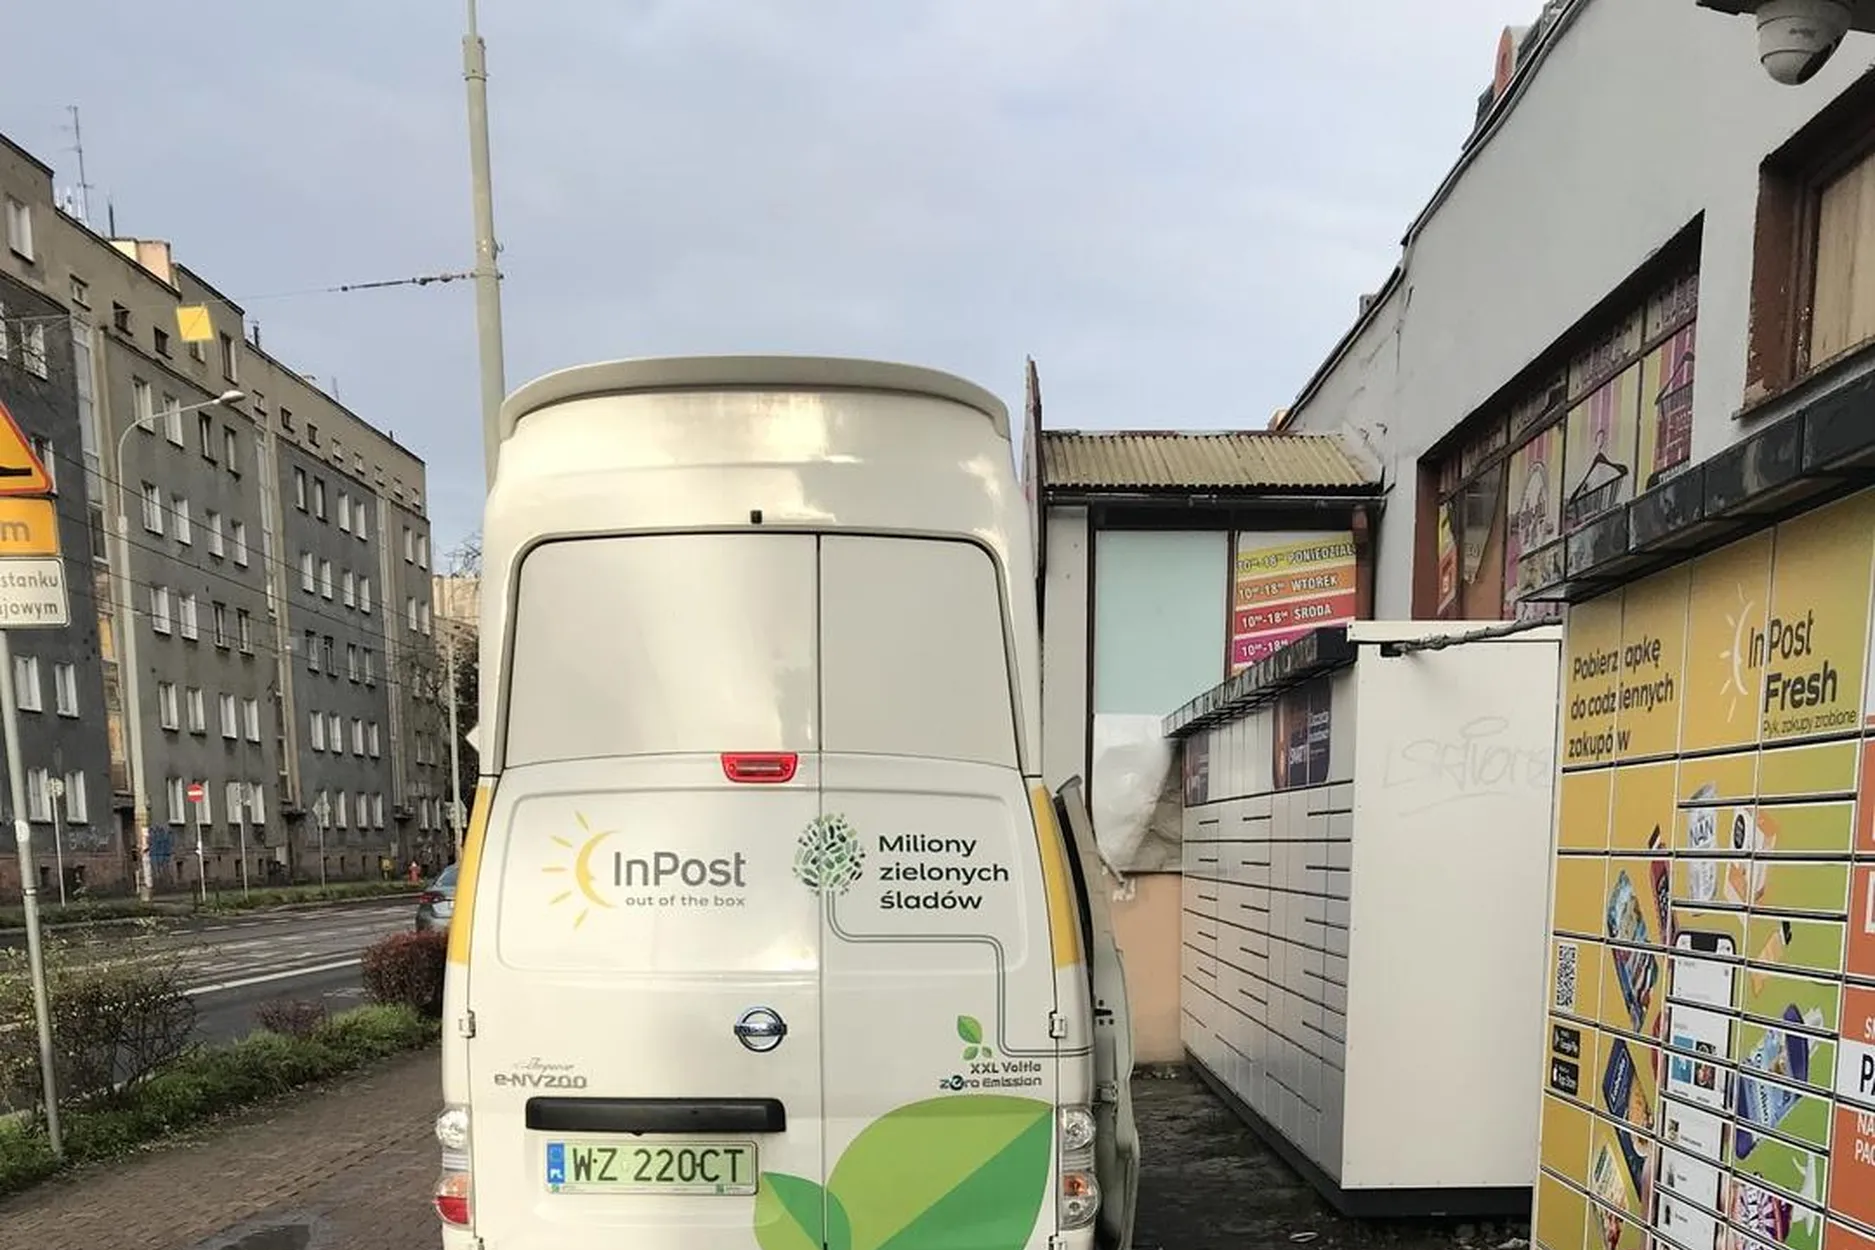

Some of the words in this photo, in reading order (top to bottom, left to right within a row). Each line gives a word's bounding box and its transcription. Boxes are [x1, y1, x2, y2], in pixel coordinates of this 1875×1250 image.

[1291, 575, 1338, 592] WTOREK
[1748, 609, 1813, 669] InPost
[1573, 647, 1619, 681] Pobierz
[1624, 635, 1661, 674] apkę
[1571, 694, 1586, 720] do
[1588, 672, 1674, 716] codziennych
[1764, 660, 1838, 713] Fresh
[1815, 709, 1857, 729] zrobione
[1569, 725, 1631, 760] zakupów
[878, 834, 977, 857] Miliony
[613, 851, 747, 887] InPost
[879, 862, 1010, 885] zielonych
[625, 896, 653, 907] out
[658, 895, 675, 907] of
[681, 895, 709, 907] the
[714, 895, 746, 907] box
[879, 890, 983, 910] śladów
[970, 1062, 1000, 1075] XXL
[1001, 1060, 1042, 1074] Voltia
[493, 1073, 588, 1089] e-NV200
[982, 1075, 1043, 1088] Emission
[572, 1148, 618, 1181] WZ
[633, 1148, 745, 1182] 220CT
